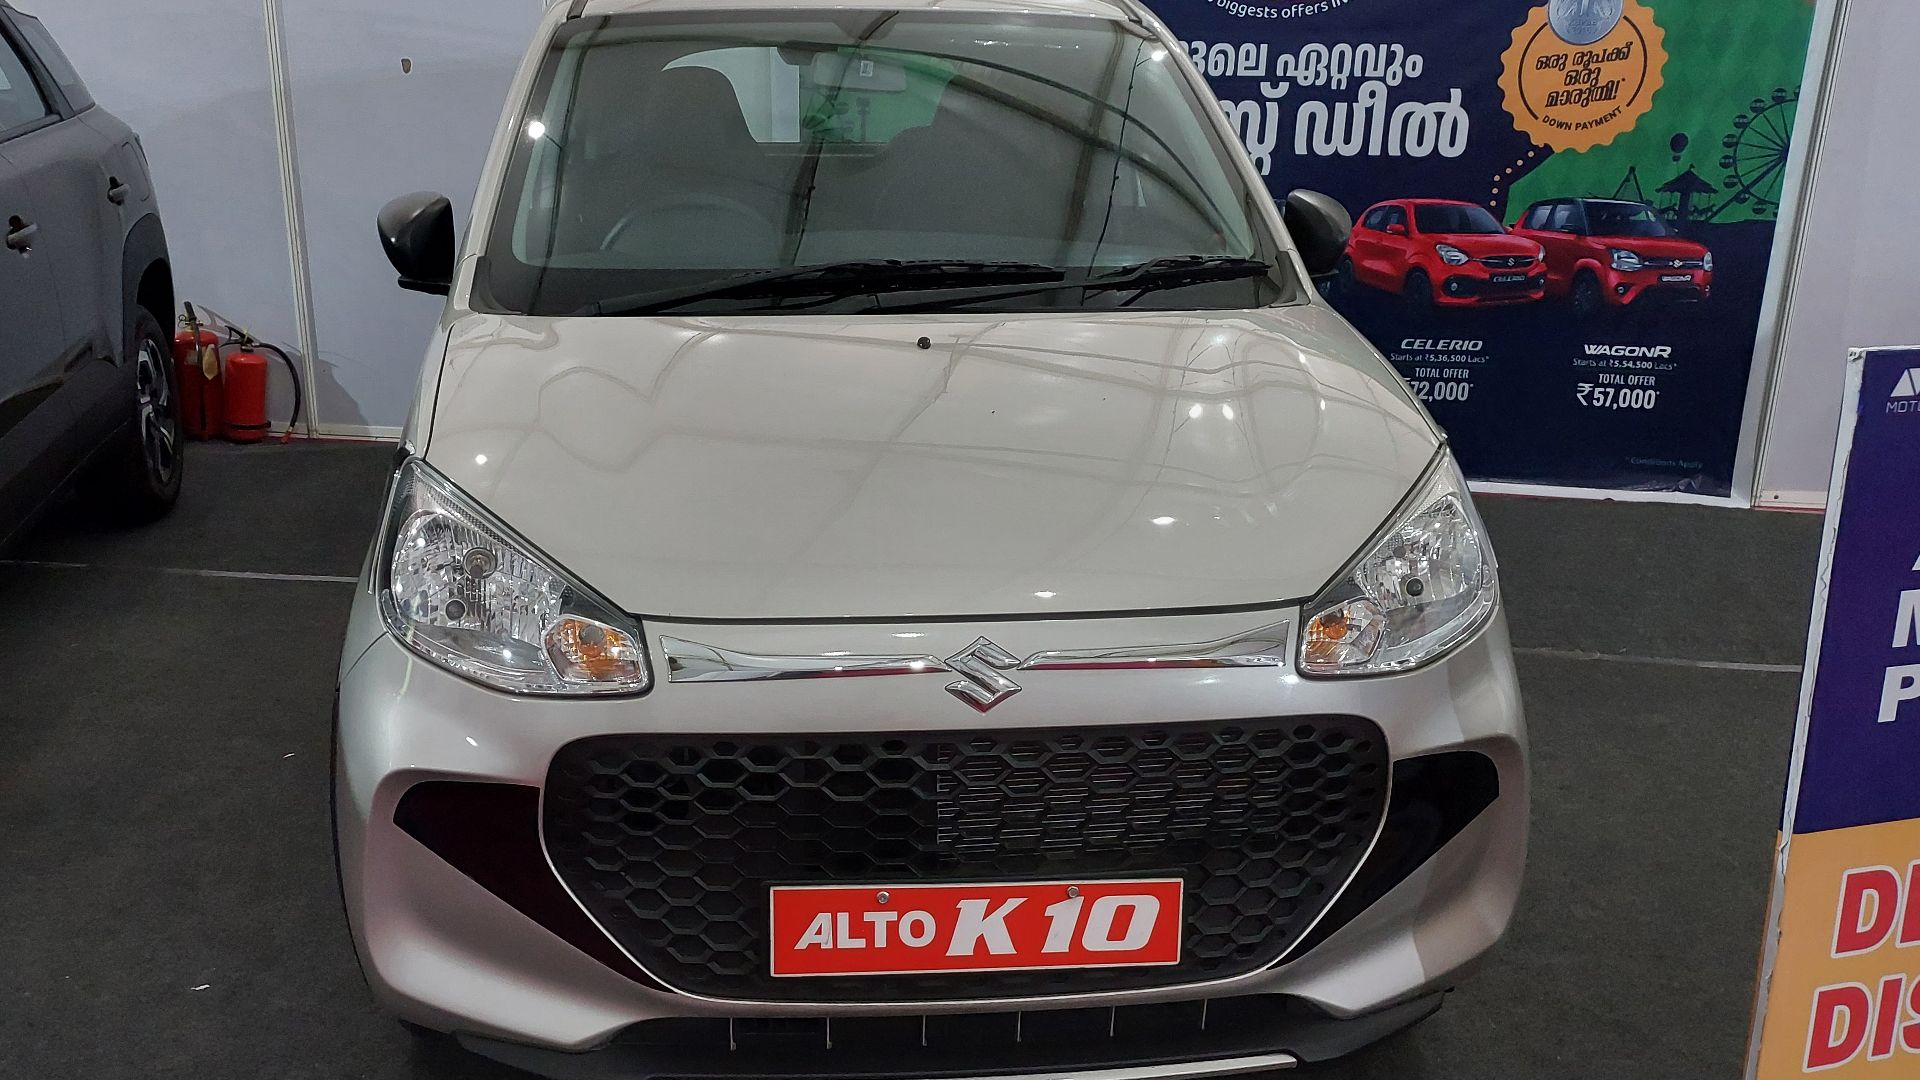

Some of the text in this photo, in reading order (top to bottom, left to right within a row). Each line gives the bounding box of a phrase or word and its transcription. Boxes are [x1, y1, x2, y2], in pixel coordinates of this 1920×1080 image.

[1281, 1, 1329, 18] offers
[1276, 43, 1424, 90] ഏറ്റവും
[1294, 80, 1470, 158] ഡീൽ
[1542, 105, 1622, 131] DOWN PAYMENT
[1401, 339, 1483, 351] CELERIO
[1584, 344, 1672, 358] WAGONR
[1390, 353, 1413, 361] Starts
[1414, 353, 1422, 361] at
[1573, 358, 1597, 367] Starts
[1598, 359, 1607, 367] at
[1415, 367, 1469, 379] TOTAL OFFER
[1599, 373, 1656, 387] TOTAL OFFER
[1886, 400, 1920, 414] MOT
[793, 910, 936, 950] ALTO
